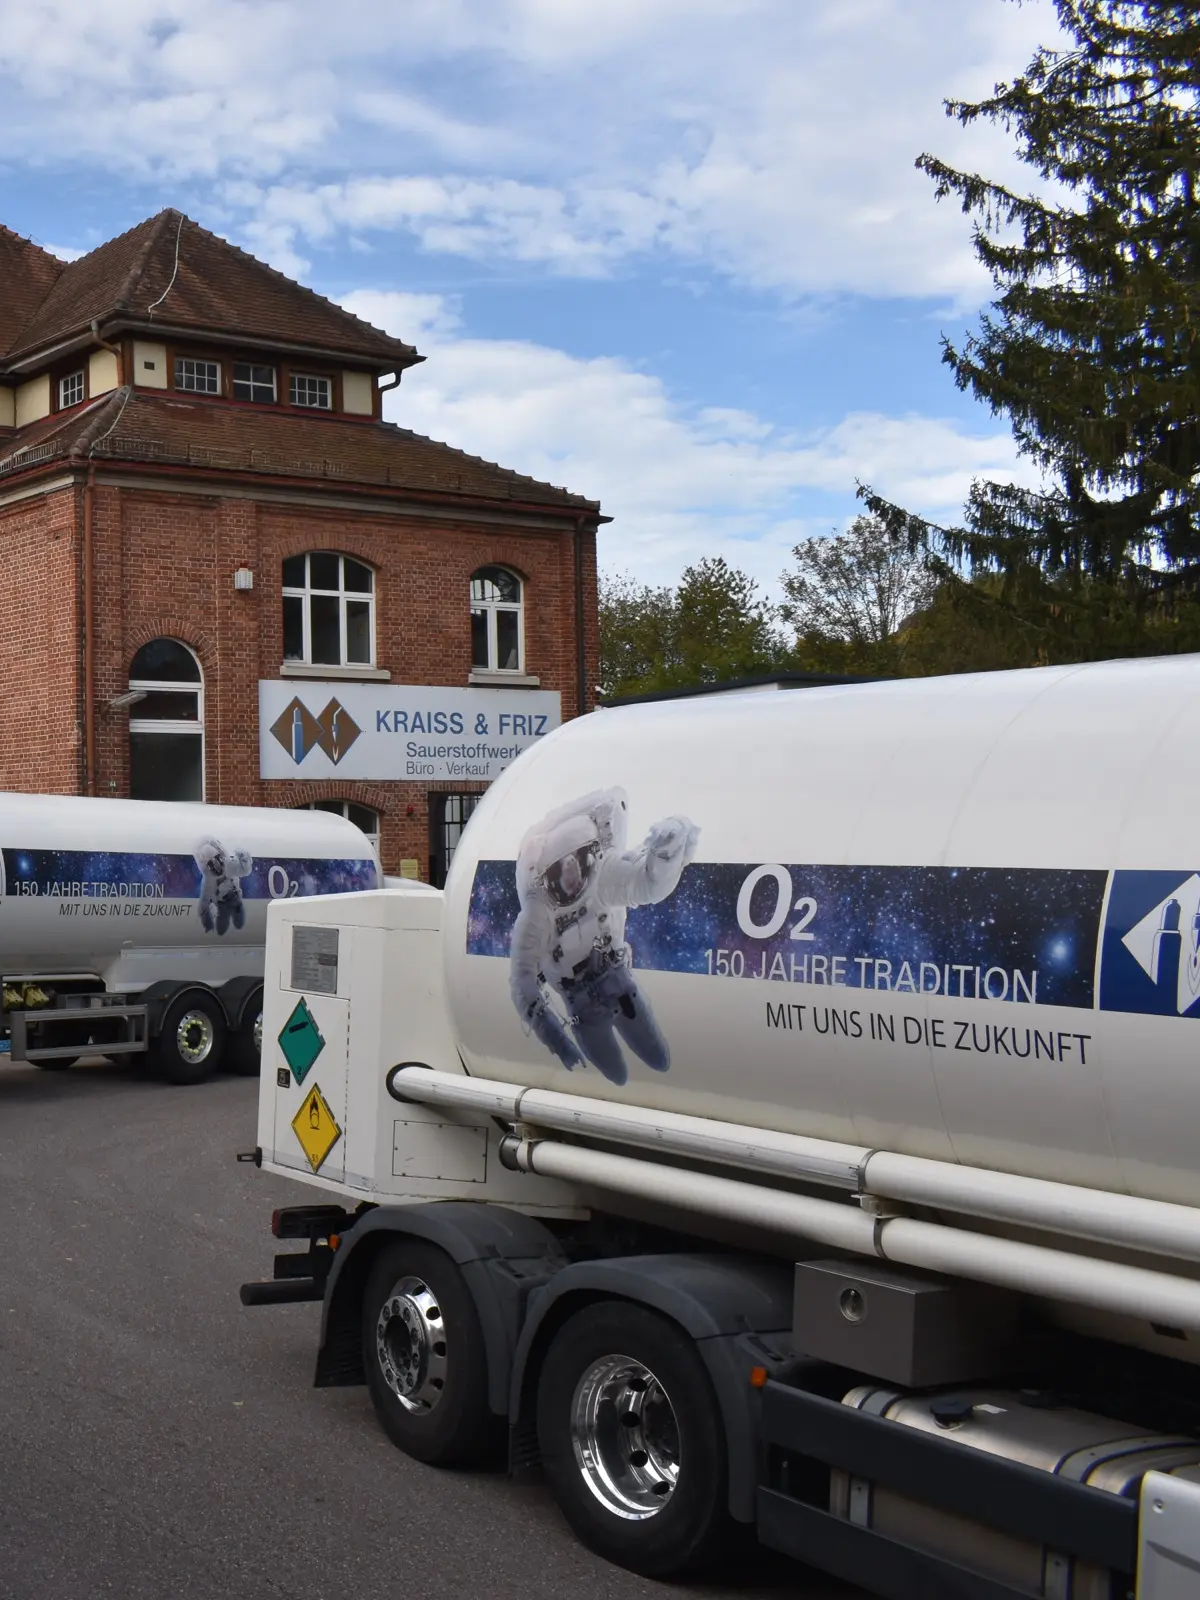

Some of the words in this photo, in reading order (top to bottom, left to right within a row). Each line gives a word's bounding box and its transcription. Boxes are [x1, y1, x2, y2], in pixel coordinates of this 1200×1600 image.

[376, 710, 464, 735] KRAISS
[474, 713, 489, 735] &
[498, 714, 548, 736] FRIZ
[406, 741, 523, 759] Sauerstoffwerk
[406, 761, 435, 775] Büro
[446, 762, 490, 776] Verkauf
[14, 881, 38, 897] 150
[42, 882, 89, 898] JAHRE
[91, 882, 164, 898] TRADITION
[59, 903, 81, 916] MIT
[83, 904, 107, 916] UNS
[109, 904, 121, 916] IN
[124, 904, 140, 916] DIE
[143, 904, 192, 916] ZUKUNFT
[703, 949, 745, 978] 150
[753, 951, 847, 987] JAHRE
[854, 957, 1038, 1004] TRADITION
[766, 1002, 806, 1031] MIT
[813, 1006, 863, 1038] UNS
[870, 1012, 895, 1042] IN
[903, 1016, 947, 1048] DIE
[953, 1021, 1092, 1065] ZUKUNFT
